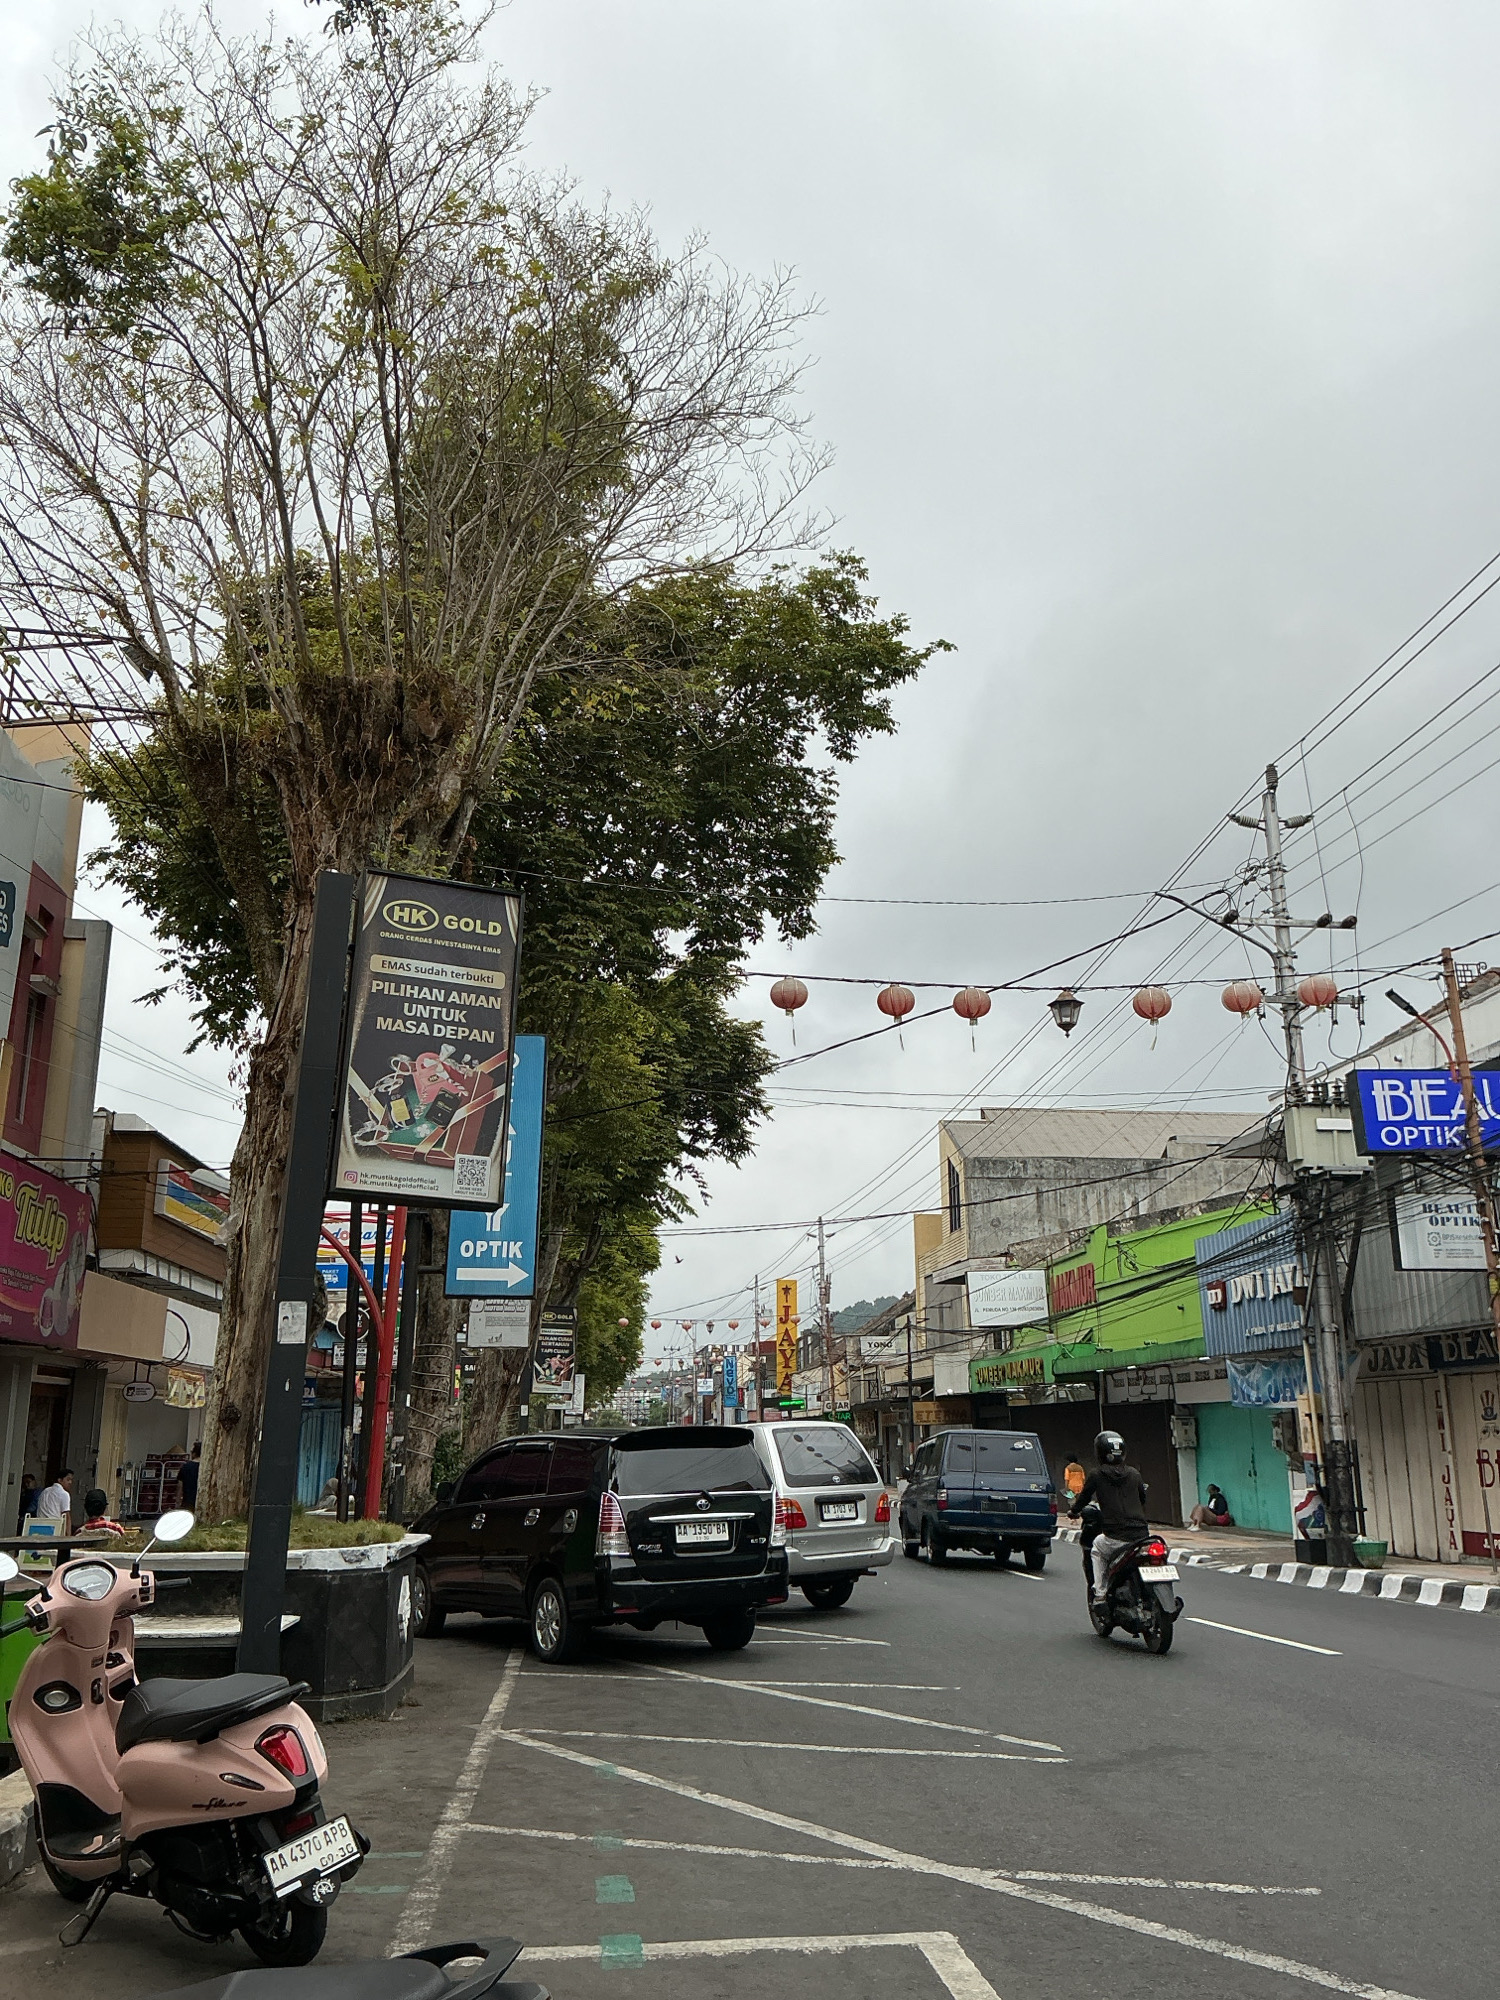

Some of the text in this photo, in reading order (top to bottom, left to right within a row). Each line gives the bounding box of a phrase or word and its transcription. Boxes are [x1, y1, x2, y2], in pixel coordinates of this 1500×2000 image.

[393, 905, 502, 936] HK GOLD
[380, 931, 501, 954] ORANG CERDAS INVESTASINYA EMAS
[381, 960, 494, 984] EMAS sudah terbukti
[371, 980, 501, 1010] PILIHAN AMAN
[403, 1002, 467, 1023] UNTUK
[376, 1016, 495, 1044] MASA DEPAN
[1381, 1126, 1462, 1147] OPTIK
[1422, 1203, 1474, 1214] BEAUT
[15, 1182, 68, 1268] Tulip
[1429, 1216, 1480, 1227] OPTIK
[460, 1240, 523, 1259] OPTIK
[981, 1273, 1001, 1281] TOKO
[1050, 1262, 1097, 1314] MAKMUR
[1231, 1271, 1265, 1304] DWI
[975, 1286, 1045, 1302] SUMBER MAKMUR
[779, 1305, 796, 1391] JAYA
[1367, 1341, 1424, 1373] JAYA
[1005, 1357, 1044, 1380] MAKMUR
[826, 1401, 849, 1409] GTAR
[828, 1412, 852, 1420] GTAR
[1476, 1449, 1500, 1488] B
[1441, 1464, 1458, 1550] JAYA
[678, 1522, 727, 1536] AA 1350 BA
[269, 1822, 348, 1874] AA 4370 APB
